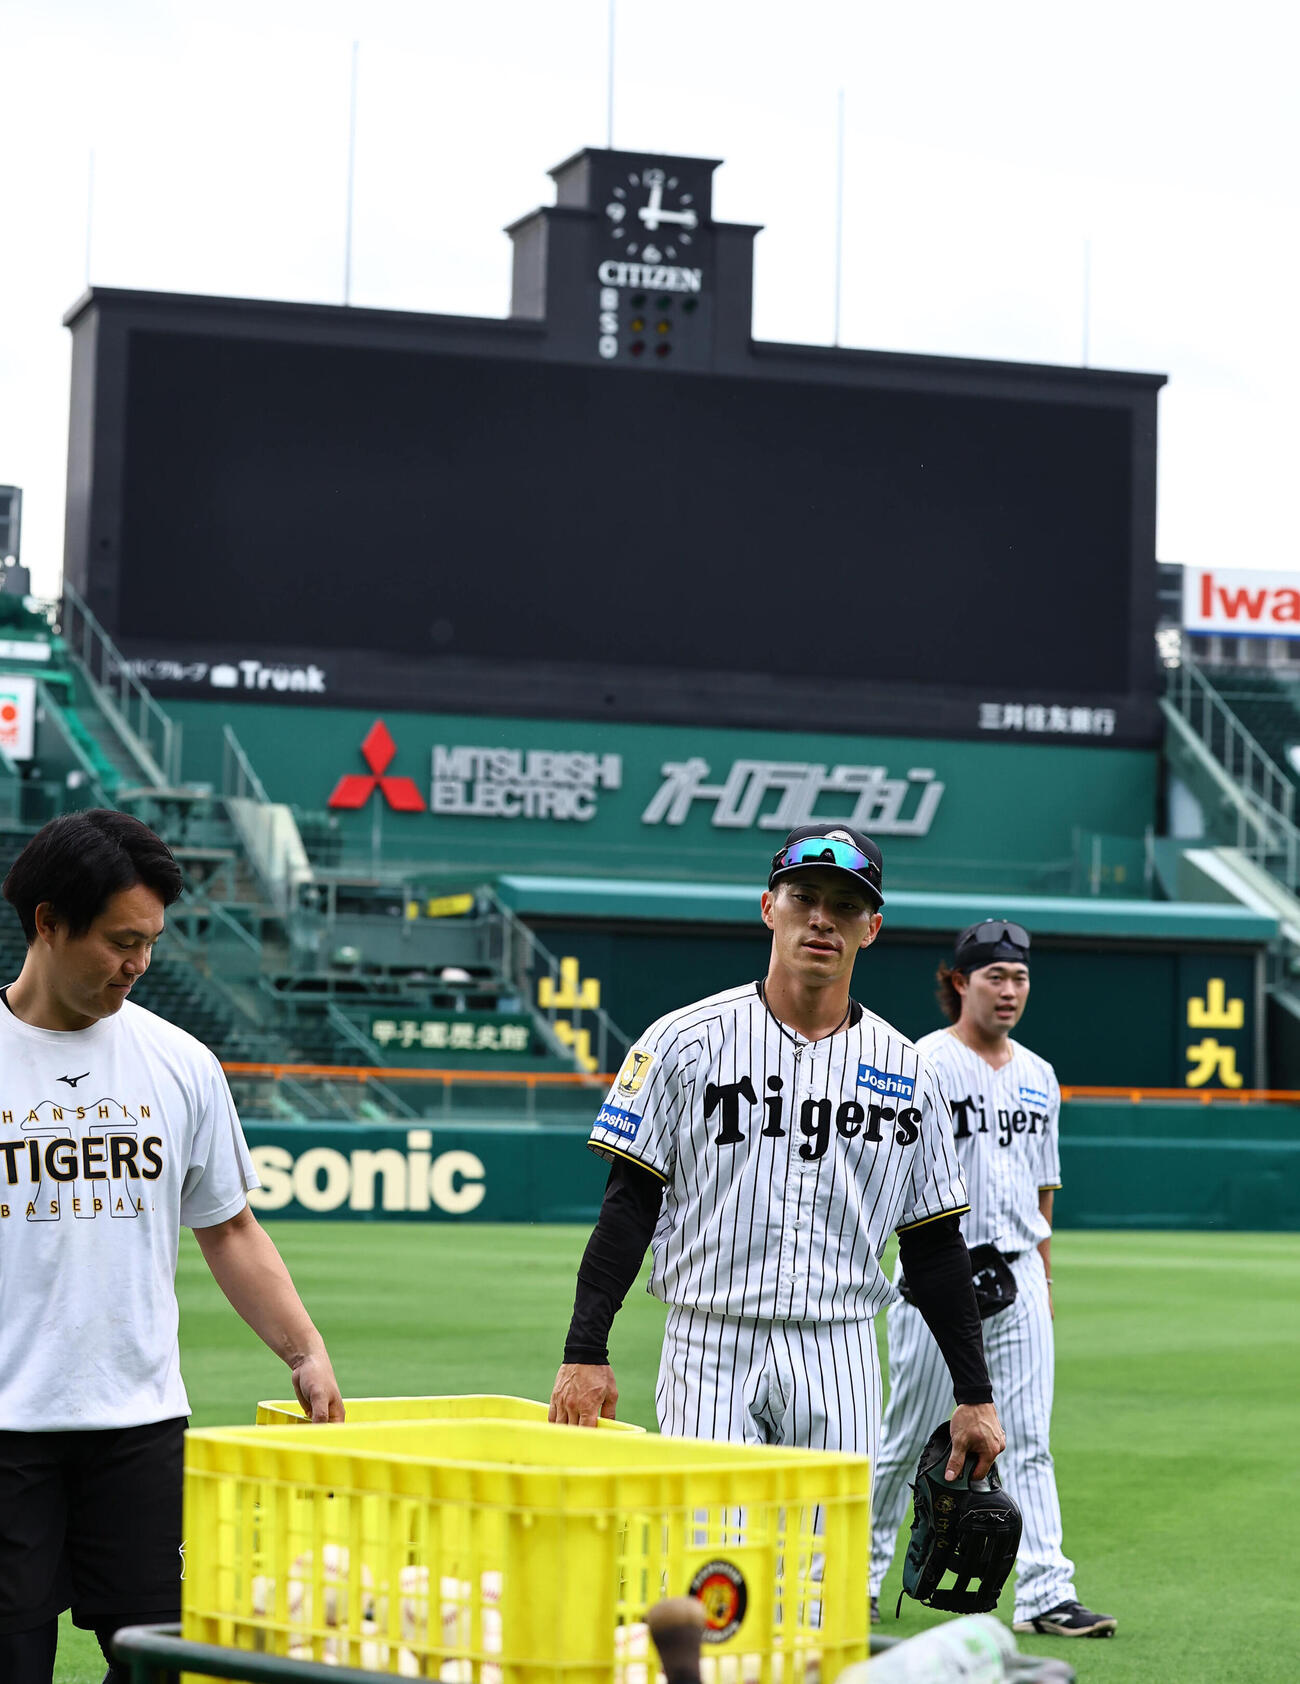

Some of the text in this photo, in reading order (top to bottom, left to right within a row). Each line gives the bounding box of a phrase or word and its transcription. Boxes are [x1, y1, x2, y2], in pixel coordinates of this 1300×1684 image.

[598, 260, 702, 292] CITIZEN
[1201, 573, 1300, 622] Iwa
[239, 660, 326, 693] Trunk
[432, 745, 622, 789] MITSUBISHI
[431, 780, 597, 821] ELECTRIC
[1186, 977, 1244, 1089] 山九
[859, 1069, 912, 1096] Joshin
[2, 1105, 151, 1125] HANSHIN
[597, 1107, 636, 1135] Joshin
[705, 1074, 922, 1161] Tigers
[0, 1136, 163, 1185] TIGERS
[247, 1129, 486, 1214] sonic
[1, 1197, 156, 1218] BASEBAL
